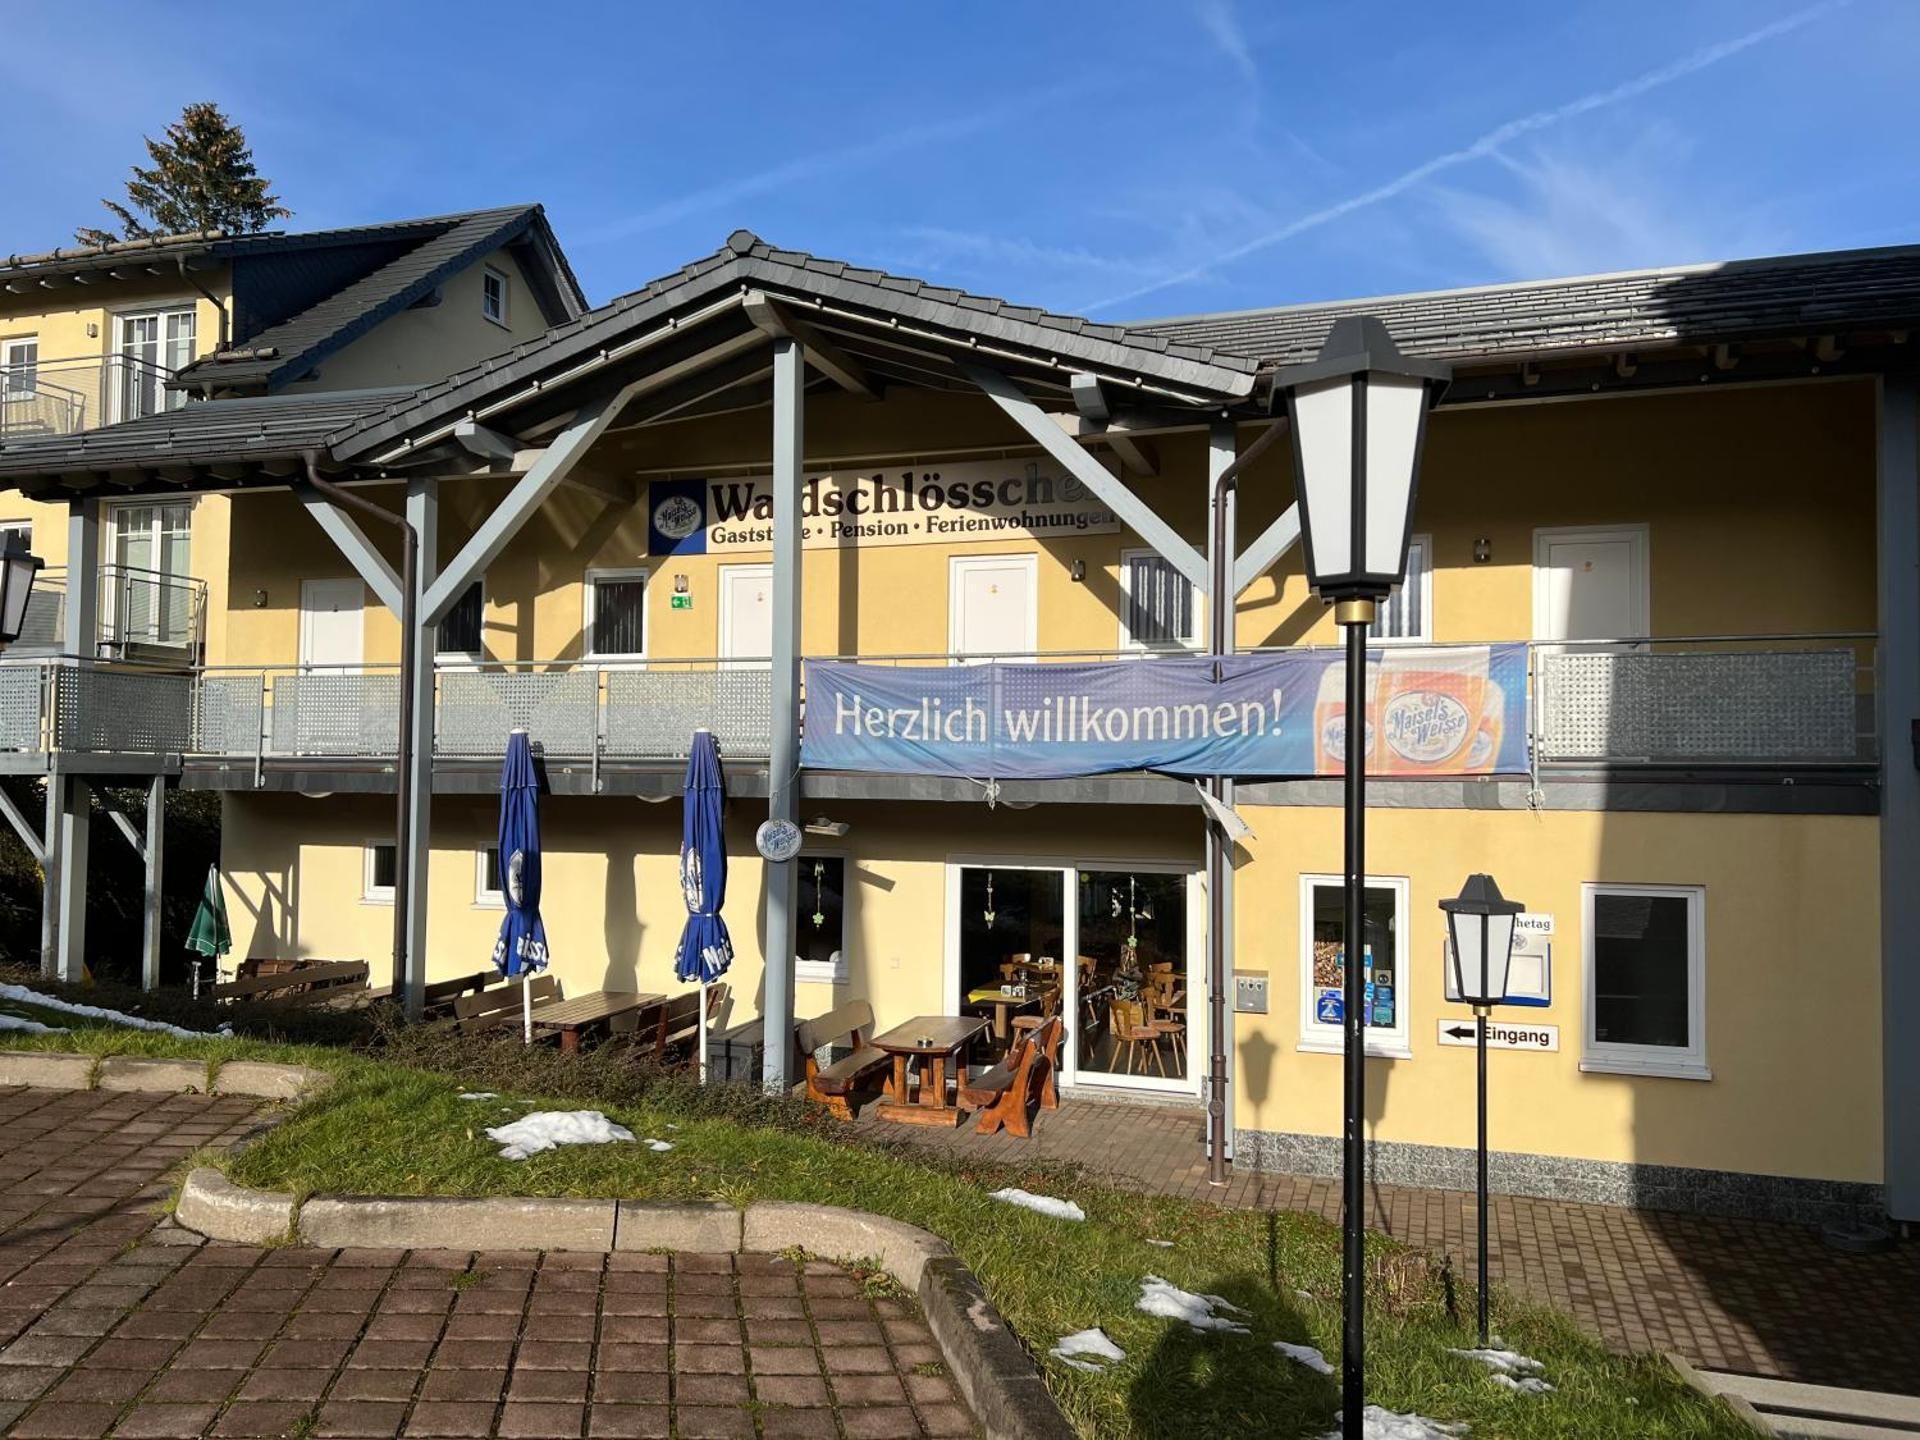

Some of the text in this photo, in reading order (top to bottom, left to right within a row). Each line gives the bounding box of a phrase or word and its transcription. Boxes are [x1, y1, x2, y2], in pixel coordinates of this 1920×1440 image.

[711, 463, 1099, 523] Wadschlössche
[711, 507, 1115, 544] Gastste Pension Ferienwohnungen
[834, 688, 1284, 744] Herzlich willkommen!
[1414, 713, 1466, 745] Weisse
[1515, 917, 1551, 931] hetag
[1484, 1026, 1550, 1047] Eingang
